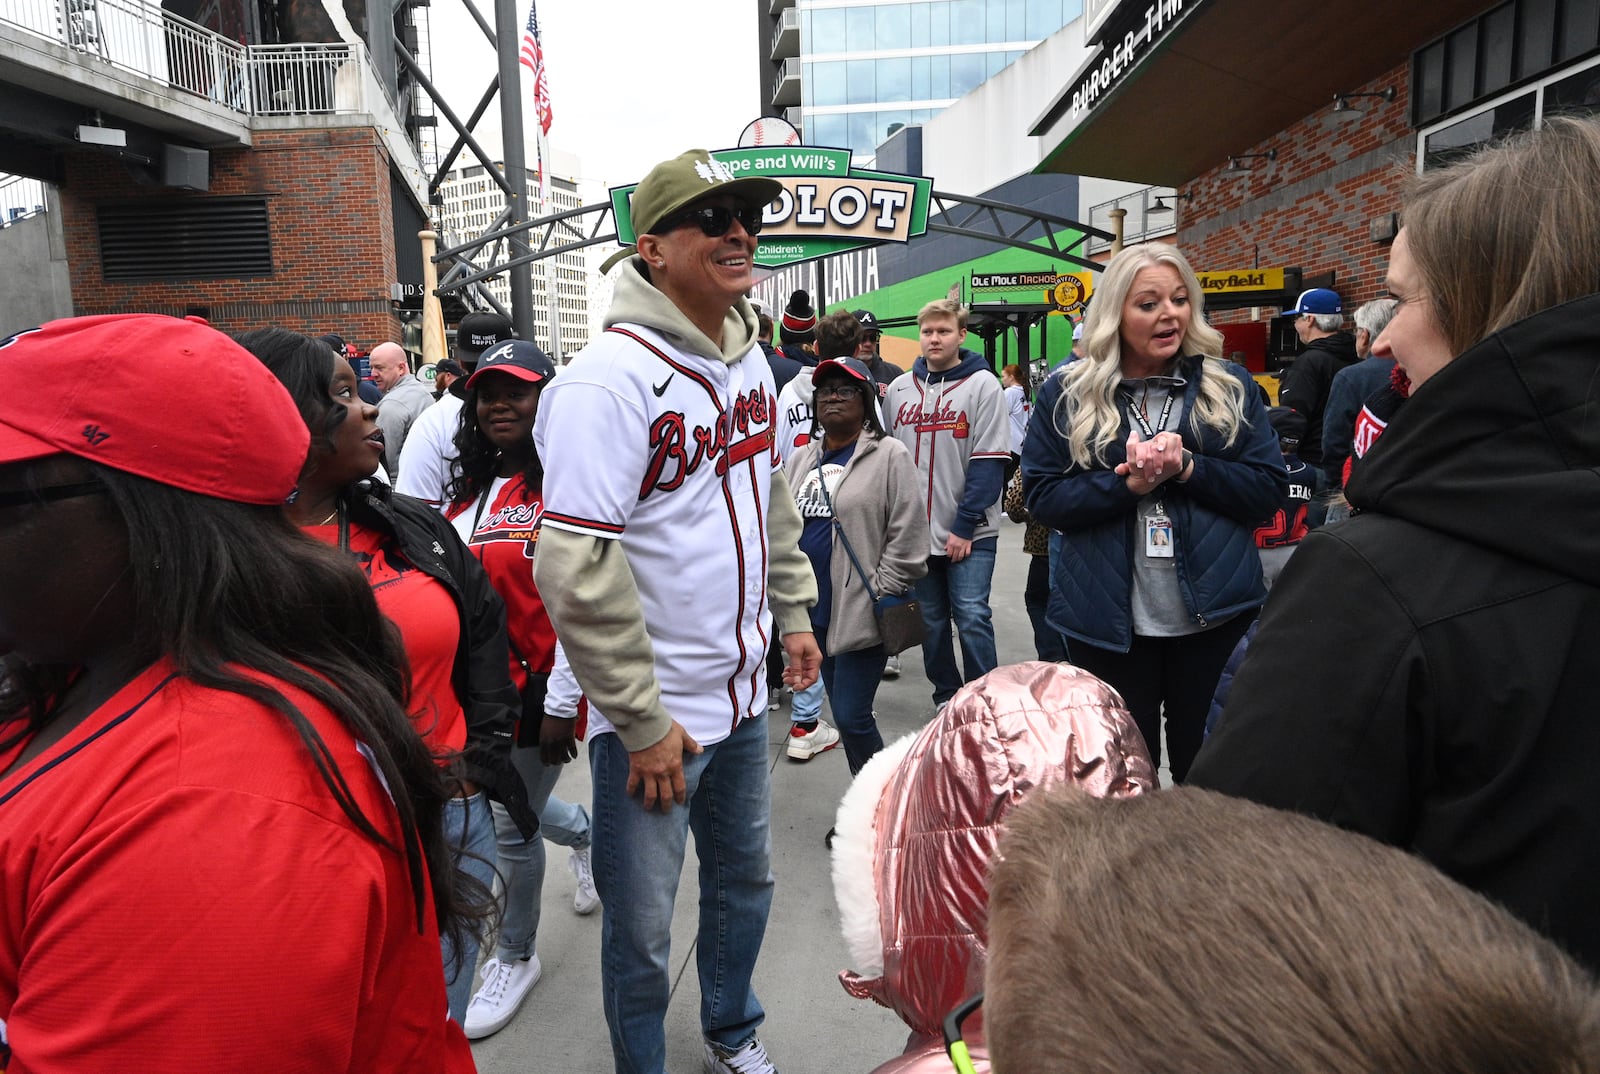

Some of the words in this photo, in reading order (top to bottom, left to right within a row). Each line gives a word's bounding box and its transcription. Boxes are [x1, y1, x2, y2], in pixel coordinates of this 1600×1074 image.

[1072, 31, 1134, 120] BURGER
[720, 160, 751, 174] ope
[755, 154, 787, 170] and
[791, 155, 837, 171] Will's
[757, 245, 804, 255] Children's
[486, 343, 514, 362] A
[893, 400, 957, 430] Atlanta
[638, 381, 769, 501] Braves
